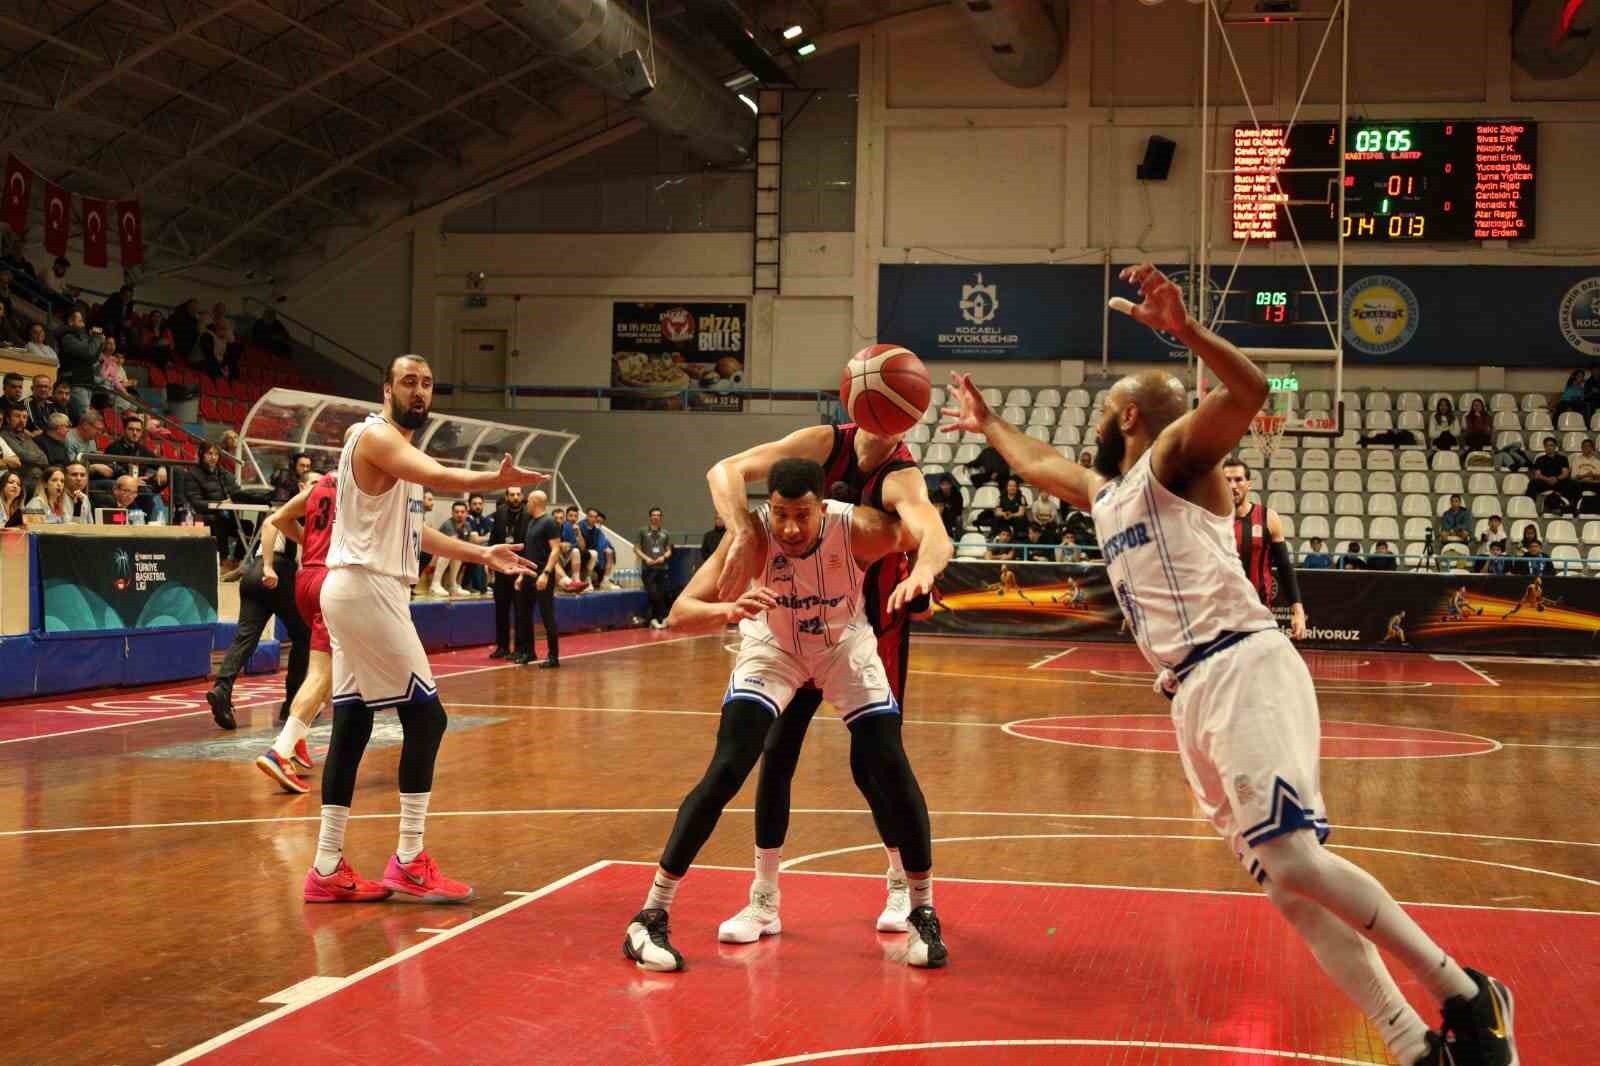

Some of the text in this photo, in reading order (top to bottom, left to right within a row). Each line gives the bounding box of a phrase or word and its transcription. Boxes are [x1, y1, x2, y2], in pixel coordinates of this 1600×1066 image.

[1388, 216, 1424, 236] 013
[1265, 304, 1285, 322] 13
[1576, 320, 1600, 328] KOC
[699, 331, 741, 352] BULLS
[135, 572, 166, 582] BASKETBOL
